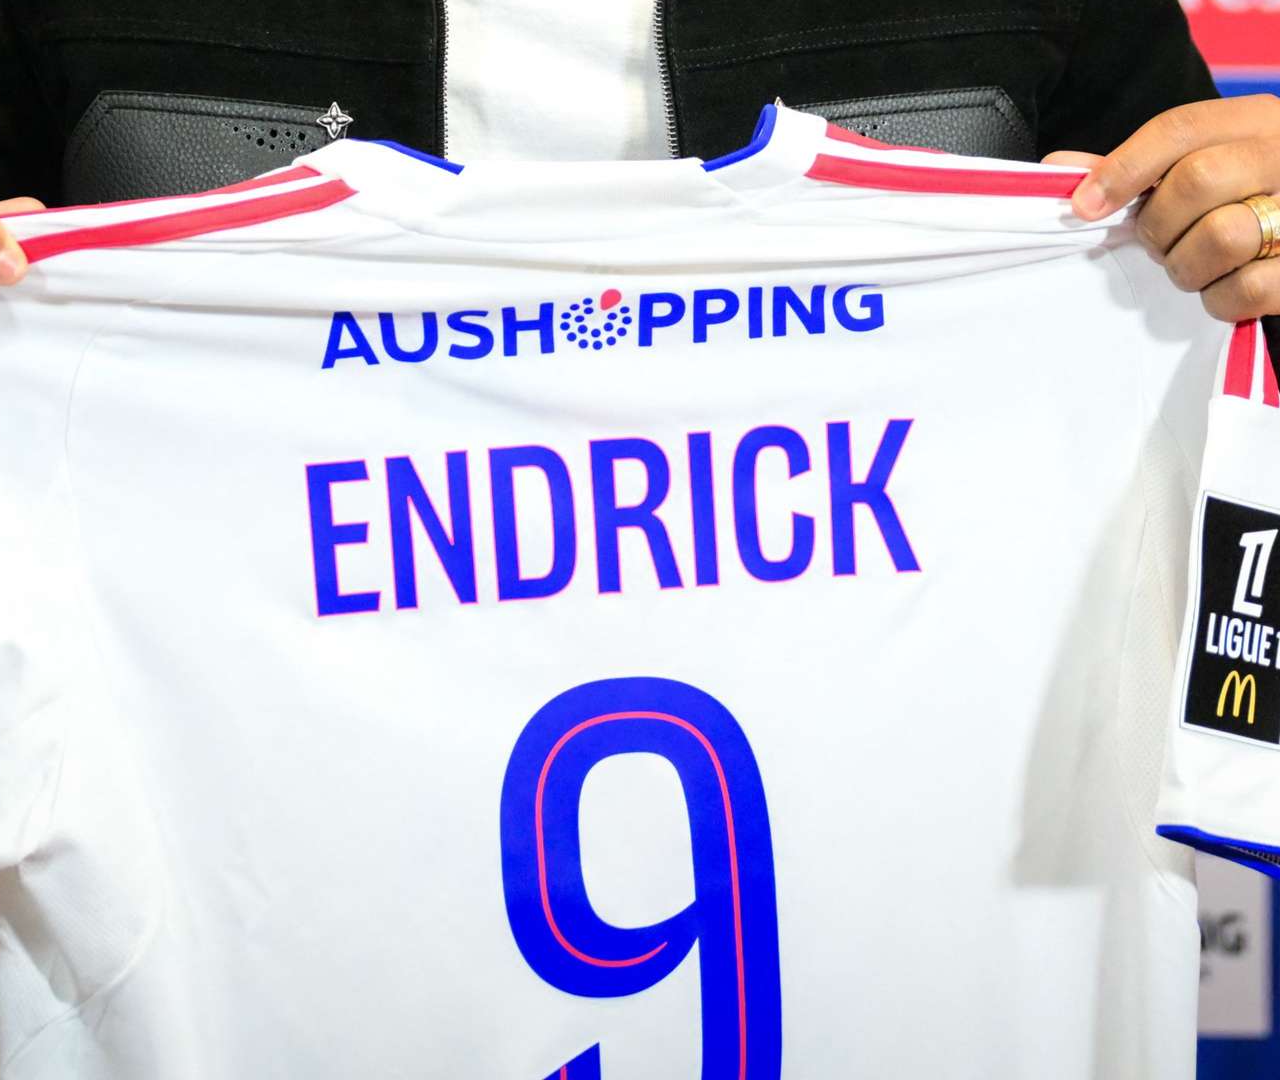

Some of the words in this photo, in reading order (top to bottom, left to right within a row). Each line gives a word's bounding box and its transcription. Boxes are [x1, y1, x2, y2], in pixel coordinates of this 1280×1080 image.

[305, 418, 922, 618] ENDRICK
[1205, 612, 1274, 667] LIGUE
[500, 676, 783, 1080] 9
